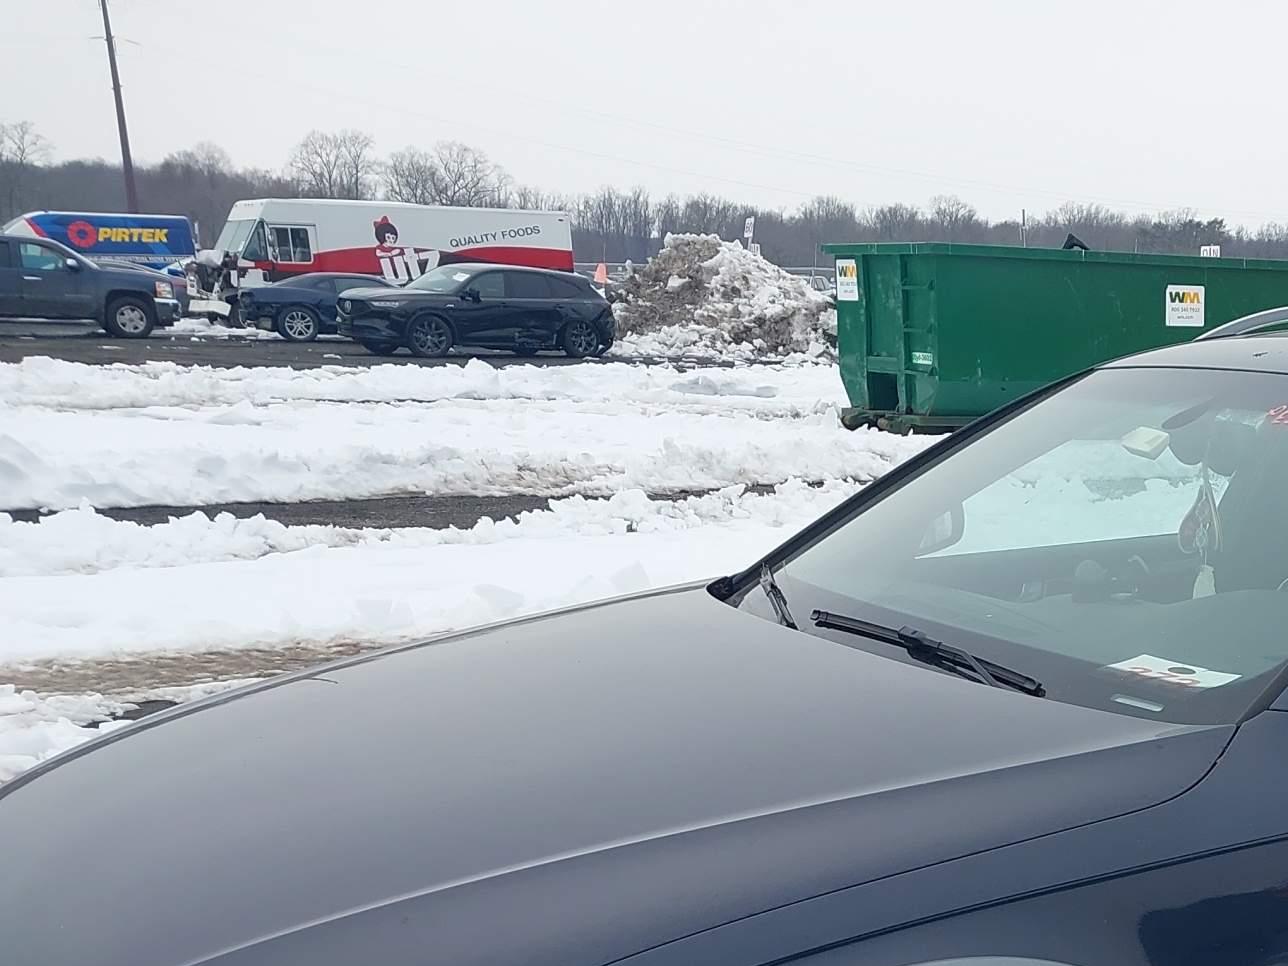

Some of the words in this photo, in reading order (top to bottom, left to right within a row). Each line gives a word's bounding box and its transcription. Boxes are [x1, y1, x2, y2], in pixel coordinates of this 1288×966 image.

[97, 227, 169, 243] PIRTEK
[450, 232, 497, 248] QUALITY
[501, 225, 541, 240] FOODS
[1169, 290, 1201, 304] WM
